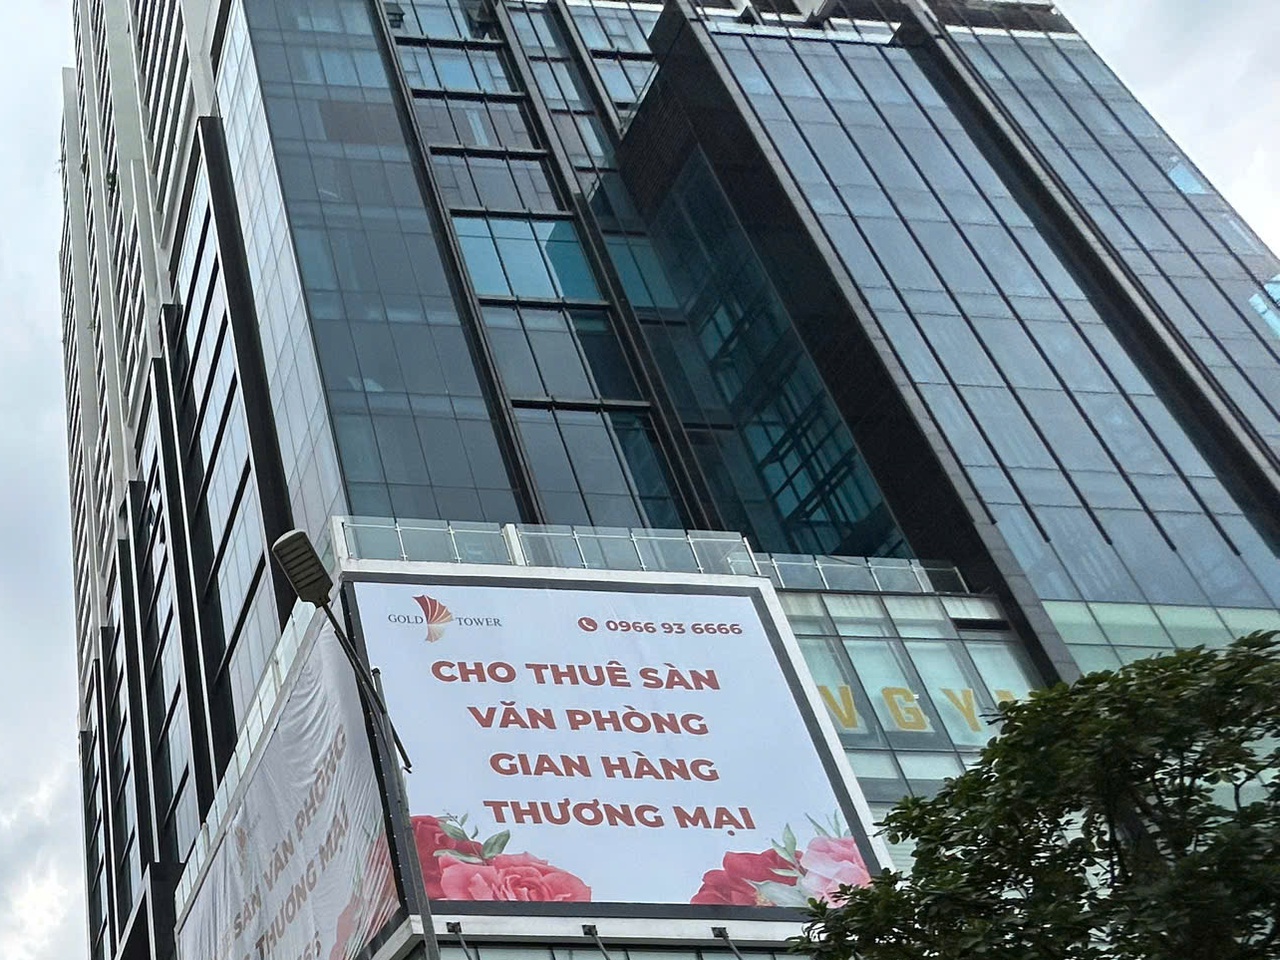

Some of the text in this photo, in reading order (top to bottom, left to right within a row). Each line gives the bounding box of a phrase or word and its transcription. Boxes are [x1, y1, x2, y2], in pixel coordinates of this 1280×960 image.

[387, 613, 502, 627] GOLD TOWER
[605, 620, 743, 635] 0966 93 6666
[431, 660, 721, 690] CHO THUÊ SÀN
[467, 701, 709, 736] VĂN PHÒNG
[489, 750, 720, 782] GIAN HÀNG
[263, 829, 295, 892] VĂN
[295, 723, 347, 842] PHÒNG
[483, 798, 756, 837] THƯƠNG MẠI
[320, 798, 350, 872] MẠI
